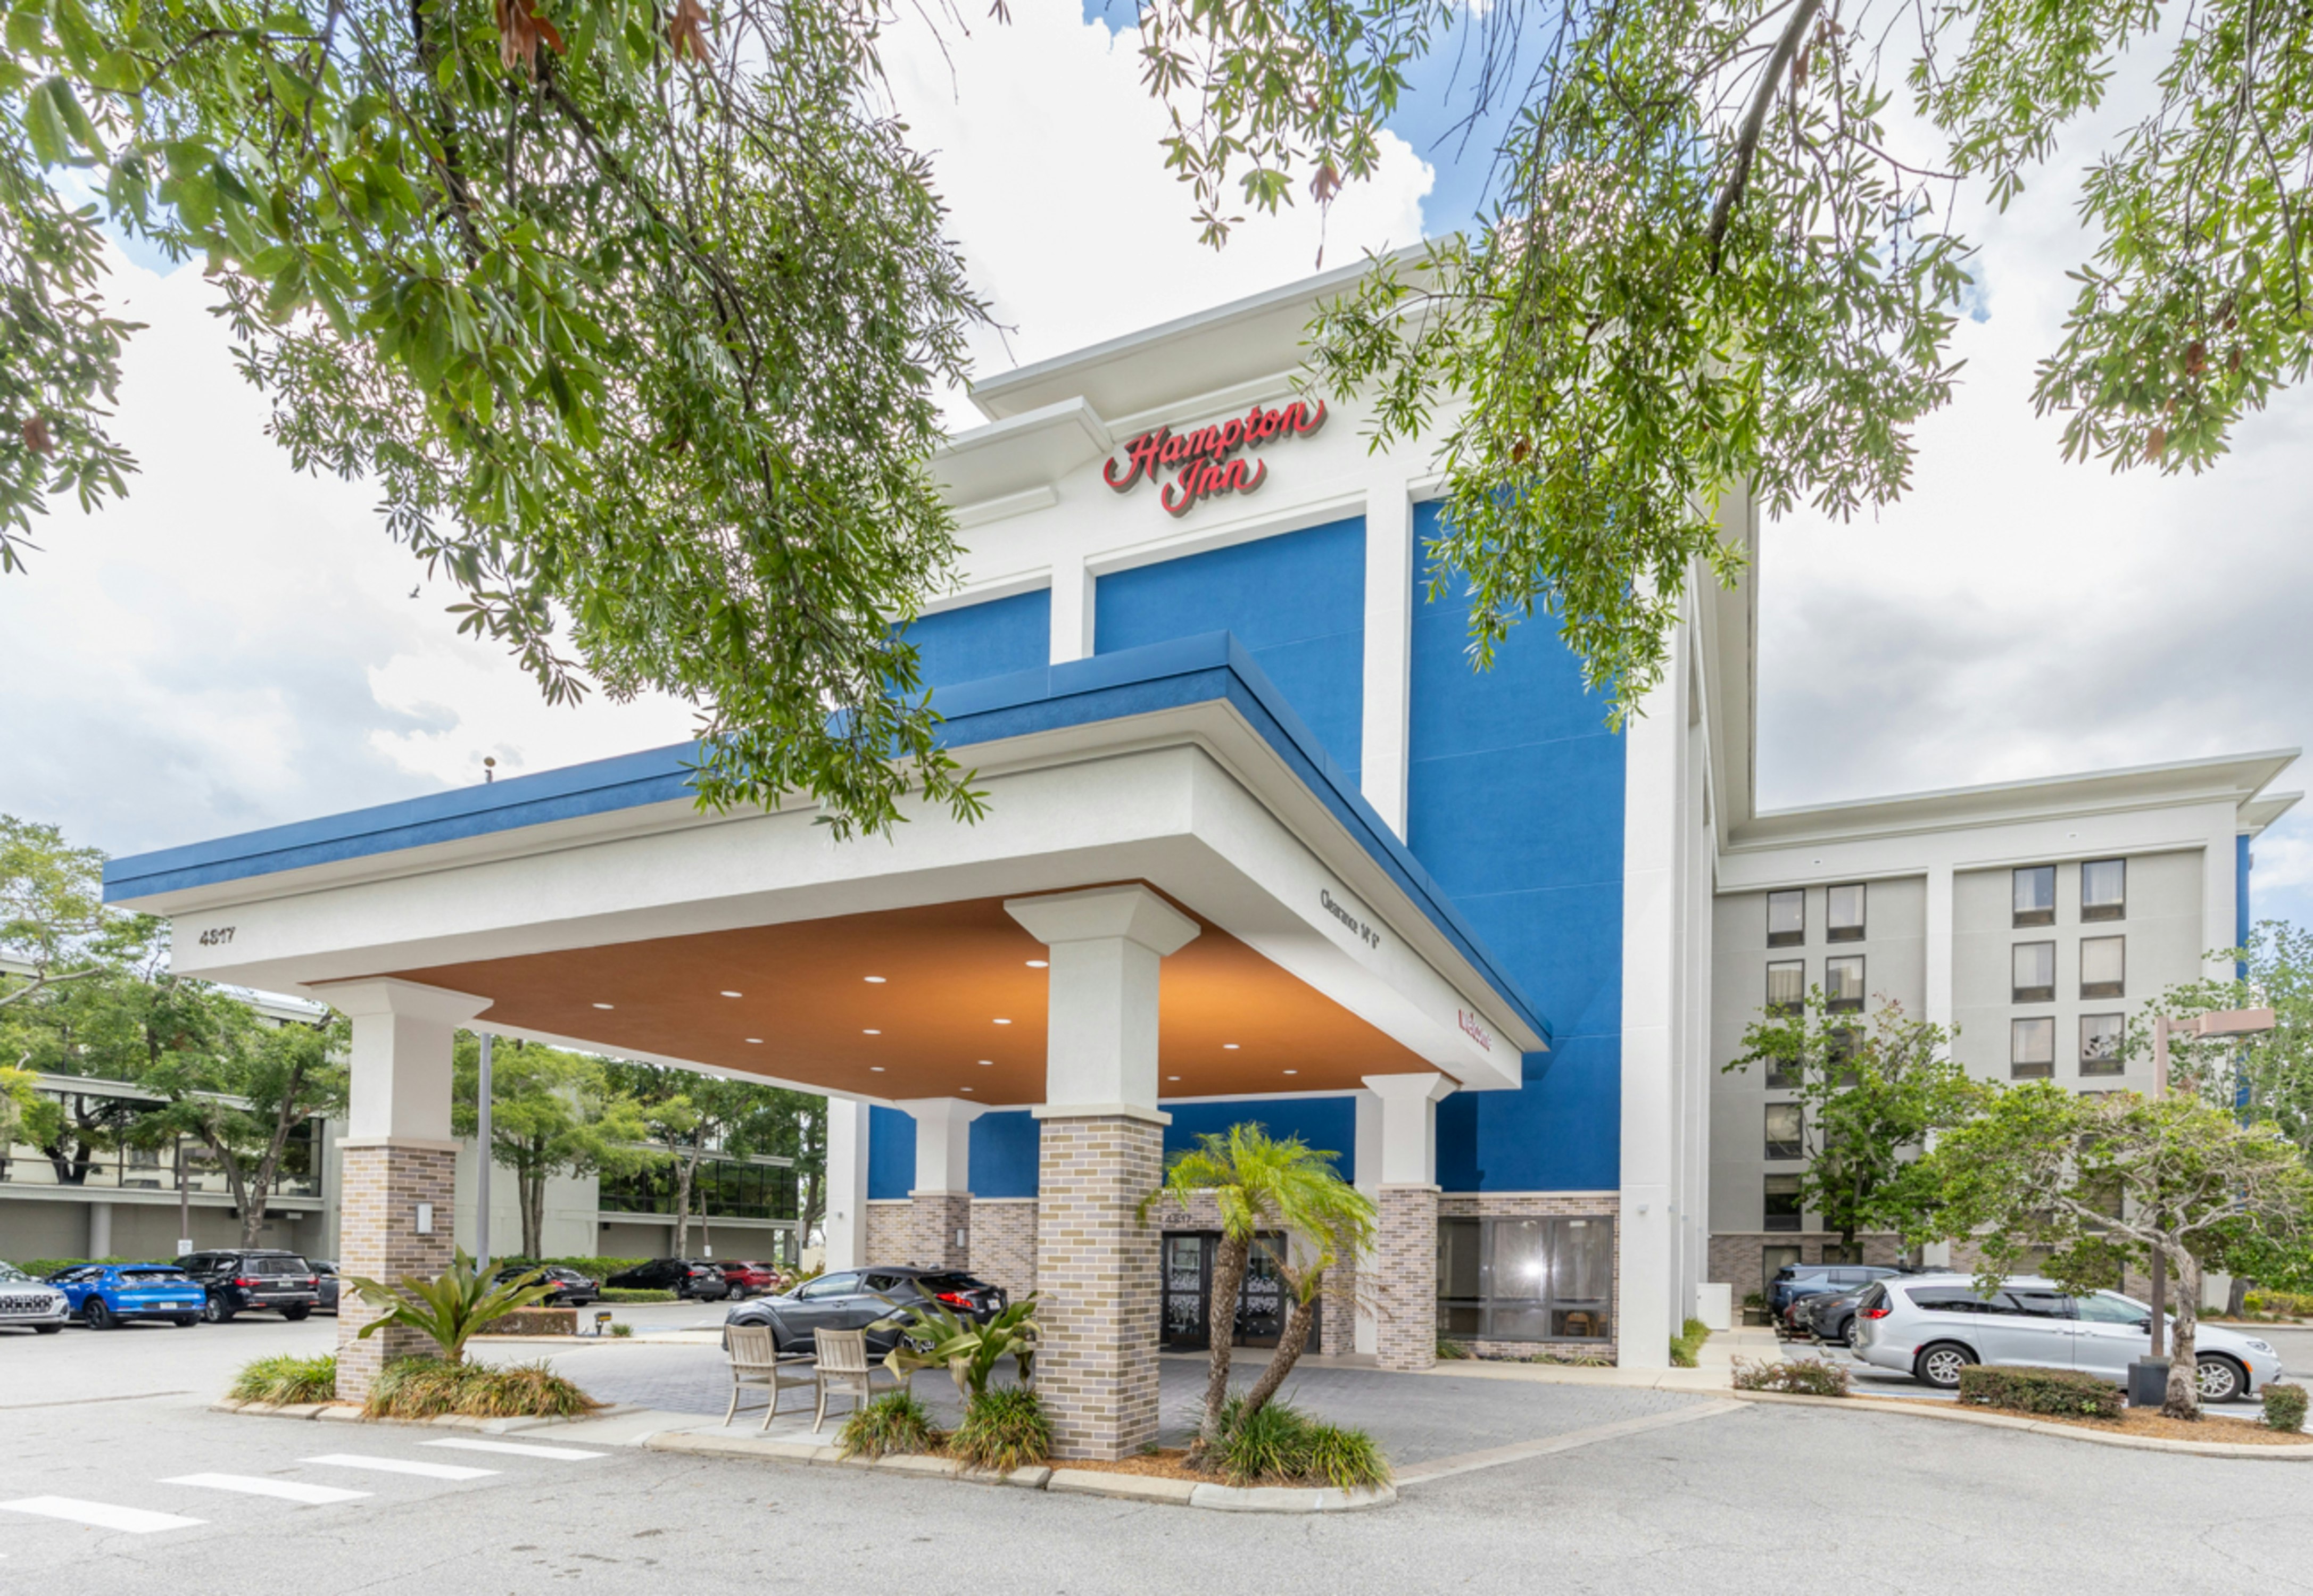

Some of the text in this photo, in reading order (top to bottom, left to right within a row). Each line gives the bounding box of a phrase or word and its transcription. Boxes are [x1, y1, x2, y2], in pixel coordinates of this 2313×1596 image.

[1104, 399, 1326, 491] Hampton
[1161, 458, 1266, 517] Inn
[199, 926, 236, 946] 4817
